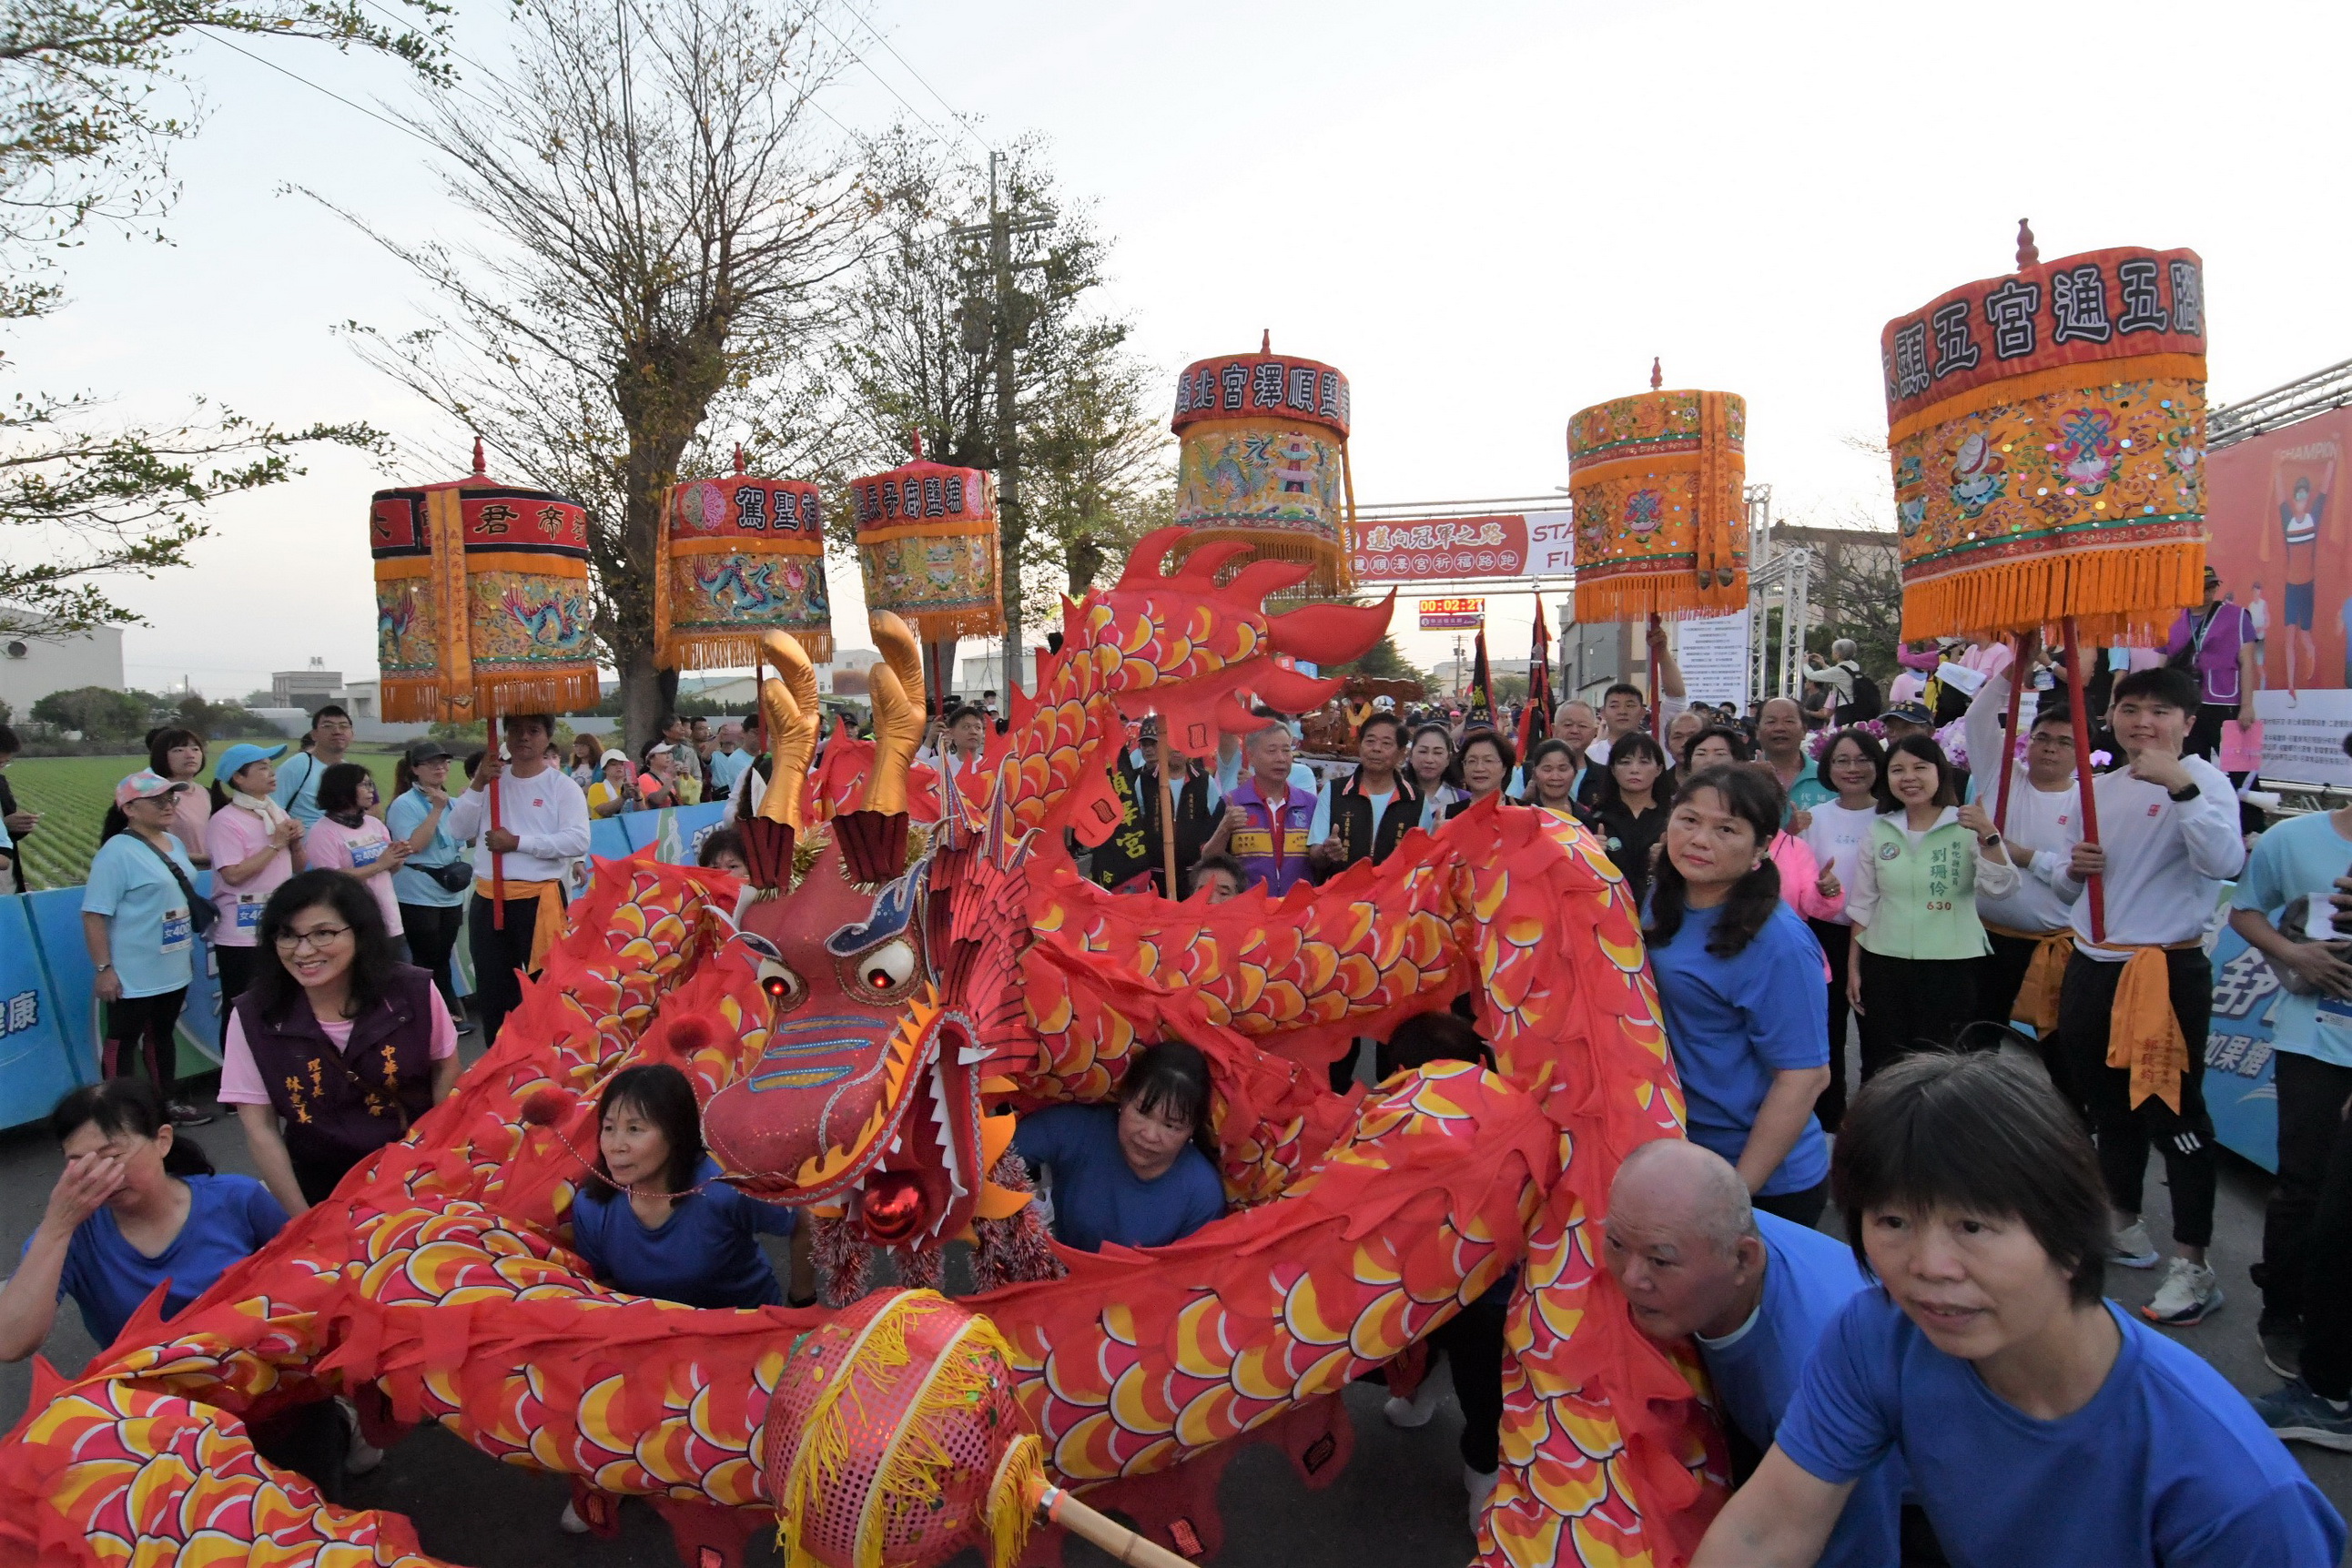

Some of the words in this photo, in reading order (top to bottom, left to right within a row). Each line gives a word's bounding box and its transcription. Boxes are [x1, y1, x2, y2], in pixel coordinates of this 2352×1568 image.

[1366, 521, 1506, 552] 邁向冠軍之路
[1421, 599, 1483, 612] 00:02:27
[1926, 901, 1952, 911] 630
